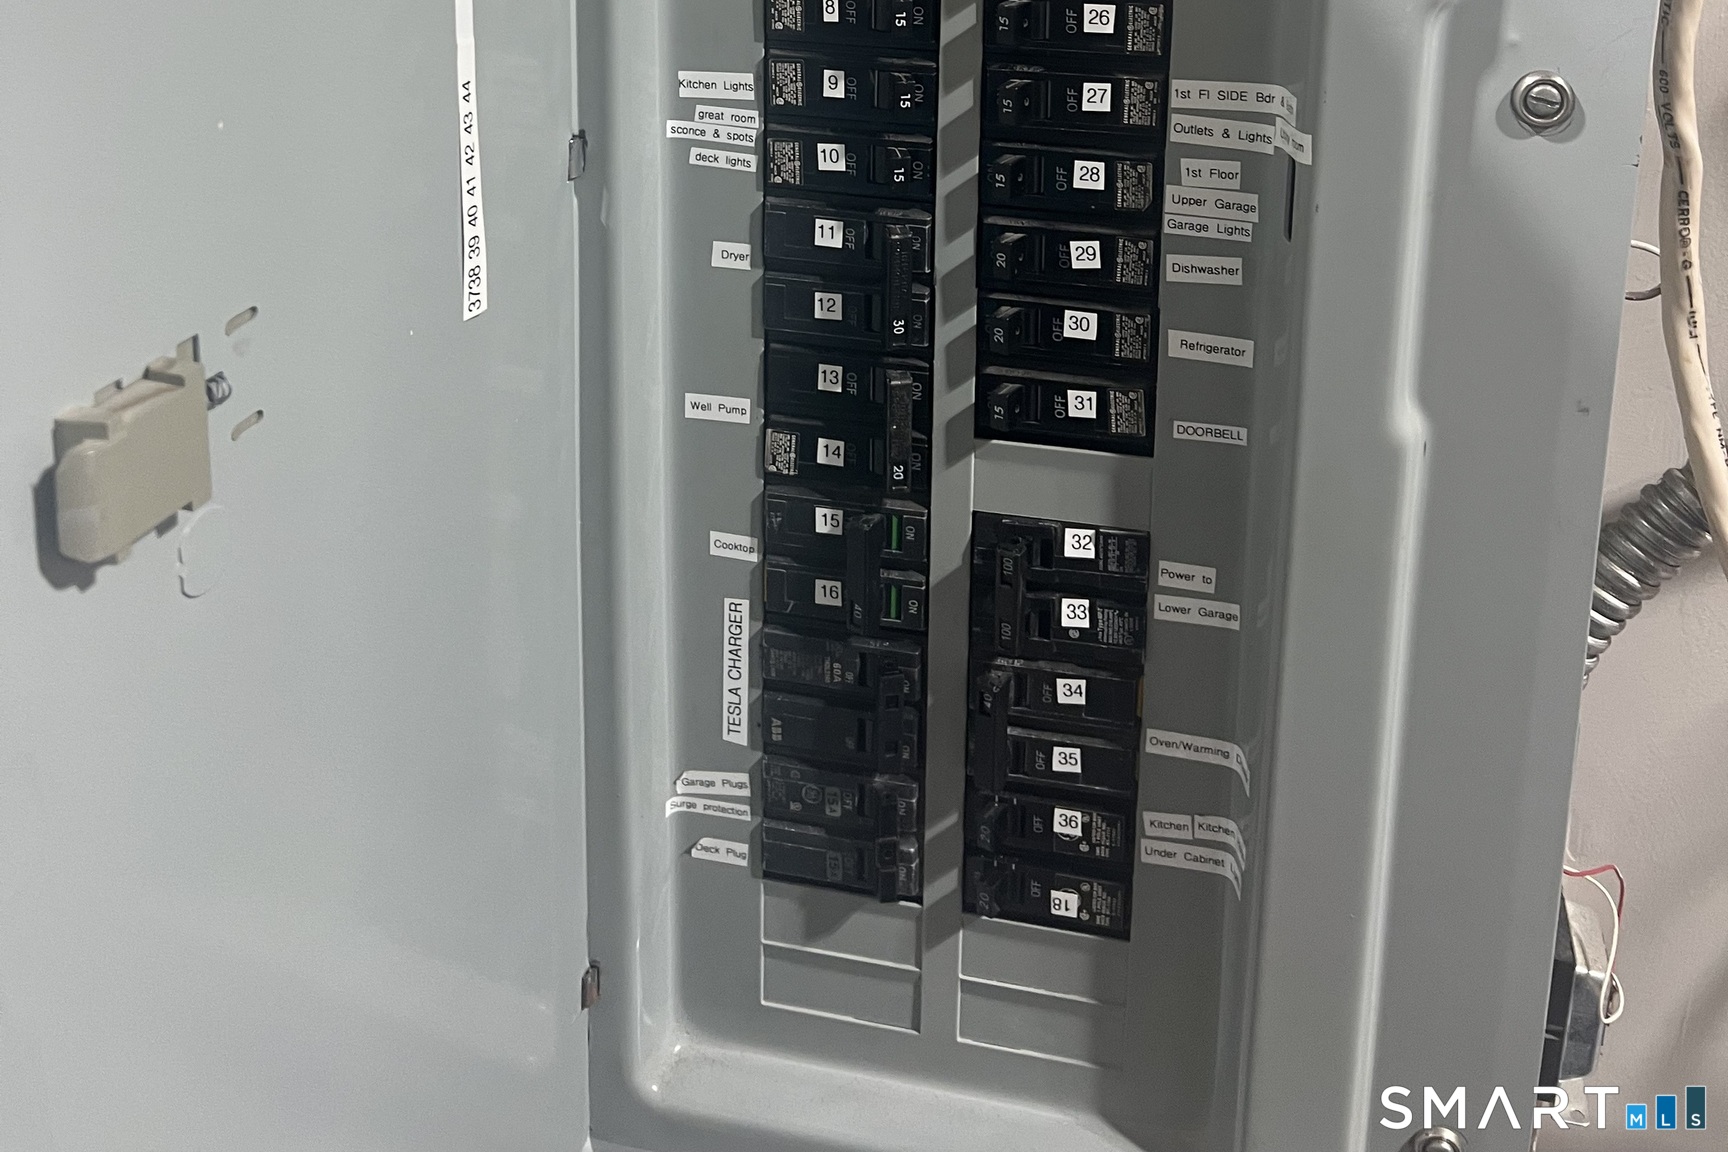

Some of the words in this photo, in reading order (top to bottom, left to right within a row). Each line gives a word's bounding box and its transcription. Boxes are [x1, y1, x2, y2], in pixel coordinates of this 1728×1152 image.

[826, 0, 834, 14] 8
[1089, 10, 1109, 25] 26
[679, 79, 716, 90] Kitchen
[724, 80, 753, 93] Lights
[828, 76, 838, 90] 9
[462, 81, 472, 103] 44
[1087, 89, 1107, 103] 27
[1174, 88, 1191, 99] 1st
[1217, 90, 1247, 102] SIDE
[1256, 92, 1275, 103] Bdr
[465, 111, 473, 134] 43
[698, 110, 724, 123] great
[731, 113, 756, 123] room
[1662, 101, 1680, 149] VOLTS
[671, 125, 706, 137] sconce
[713, 129, 720, 139] &
[726, 132, 754, 143] spots
[1174, 123, 1214, 138] Outlets
[1222, 128, 1230, 139] &
[1238, 129, 1272, 145] Lights
[465, 143, 475, 165] 42
[695, 151, 719, 164] deck
[725, 155, 752, 168] lights
[821, 148, 839, 164] 10
[1079, 167, 1099, 182] 28
[1186, 168, 1201, 179] 1st
[1210, 169, 1239, 180] Floor
[468, 176, 476, 196] 41
[1172, 195, 1206, 209] Upper
[1215, 199, 1256, 214] Garage
[468, 205, 478, 227] 40
[818, 225, 834, 239] 11
[1167, 219, 1208, 235] Garage
[1217, 223, 1251, 237] Lights
[469, 235, 479, 258] 39
[721, 249, 749, 263] Dryer
[1076, 247, 1096, 262] 29
[1172, 262, 1239, 276] Dishwasher
[818, 297, 836, 312] 12
[1069, 316, 1090, 332] 30
[1180, 339, 1245, 357] Refrigerator
[821, 369, 839, 385] 13
[690, 400, 712, 412] Well
[718, 403, 747, 416] Pump
[1074, 396, 1093, 411] 31
[1177, 425, 1243, 441] DOORBELL
[823, 444, 841, 458] 14
[821, 514, 840, 528] 15
[714, 539, 755, 554] Cooktop
[1072, 535, 1093, 550] 32
[1161, 569, 1195, 584] Power
[1202, 575, 1212, 585] to
[820, 585, 838, 599] 16
[1066, 605, 1087, 620] 33
[1158, 603, 1192, 617] Lower
[1198, 608, 1238, 622] Garage
[729, 602, 743, 667] CHARGER
[1063, 684, 1083, 697] 34
[728, 672, 742, 735] TESLA
[1150, 736, 1230, 759] Oven/Warming
[1058, 753, 1078, 765] 35
[681, 777, 715, 789] Garage
[722, 779, 747, 790] Plugs
[703, 804, 748, 816] protection
[1058, 815, 1078, 829] 36
[1150, 820, 1189, 833] Kitchen
[1198, 822, 1234, 836] Kitchen
[725, 847, 746, 861] Plug
[1145, 846, 1177, 860] Under
[1184, 852, 1225, 868] Cabinet
[1052, 898, 1070, 912] 18
